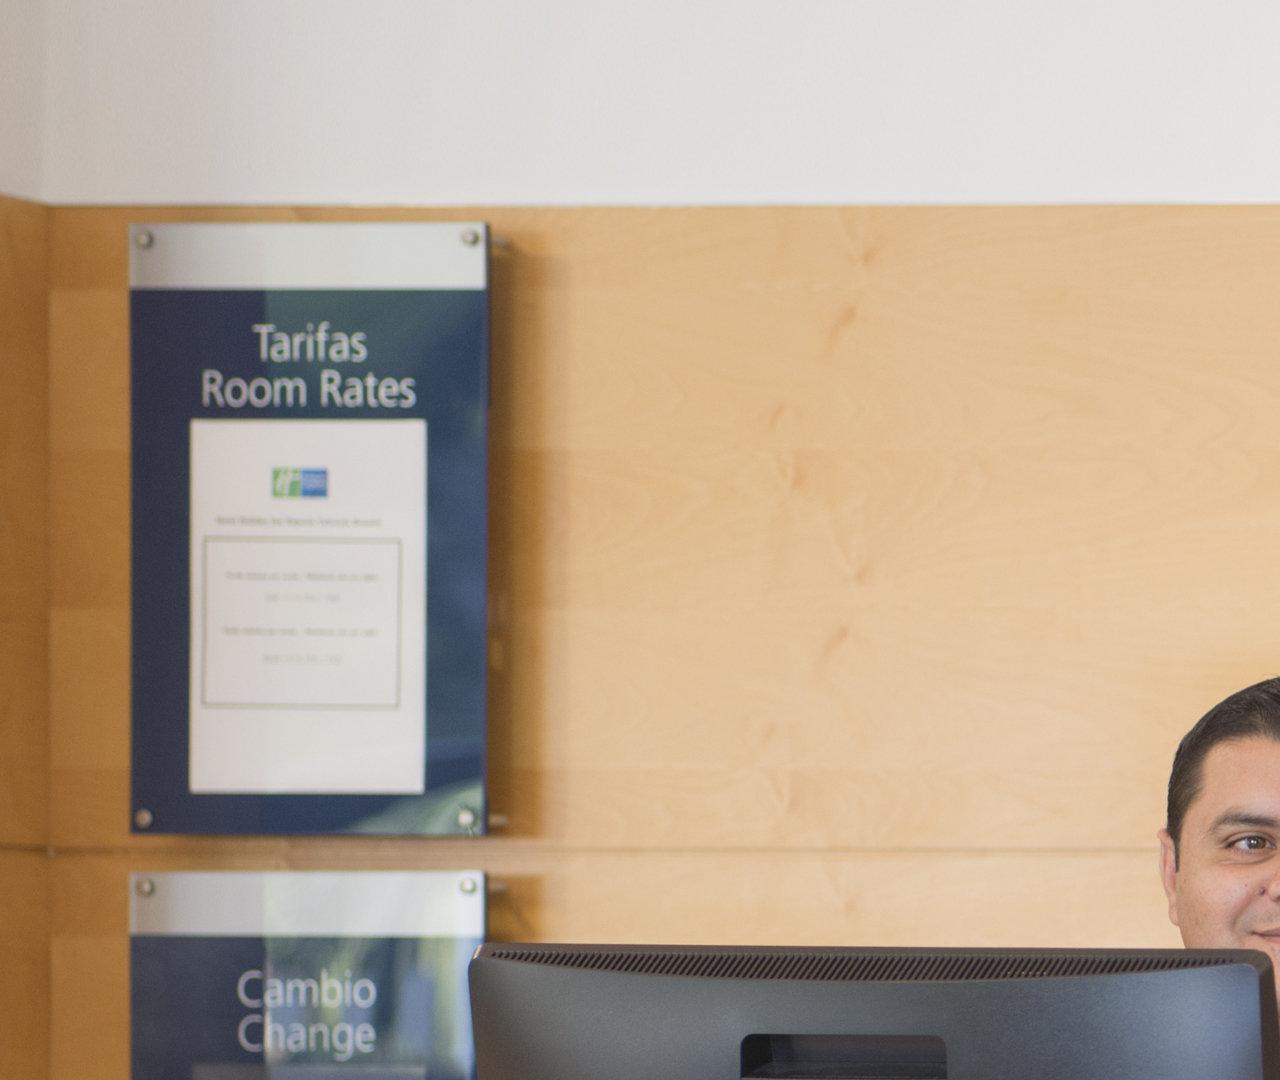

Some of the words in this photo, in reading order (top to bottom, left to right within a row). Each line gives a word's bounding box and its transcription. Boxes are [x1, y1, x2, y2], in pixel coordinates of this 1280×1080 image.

[252, 321, 368, 363] Tarifas
[202, 369, 307, 409] Room
[320, 369, 416, 409] Rates
[236, 969, 377, 1009] Cambio
[236, 1014, 377, 1062] Change
